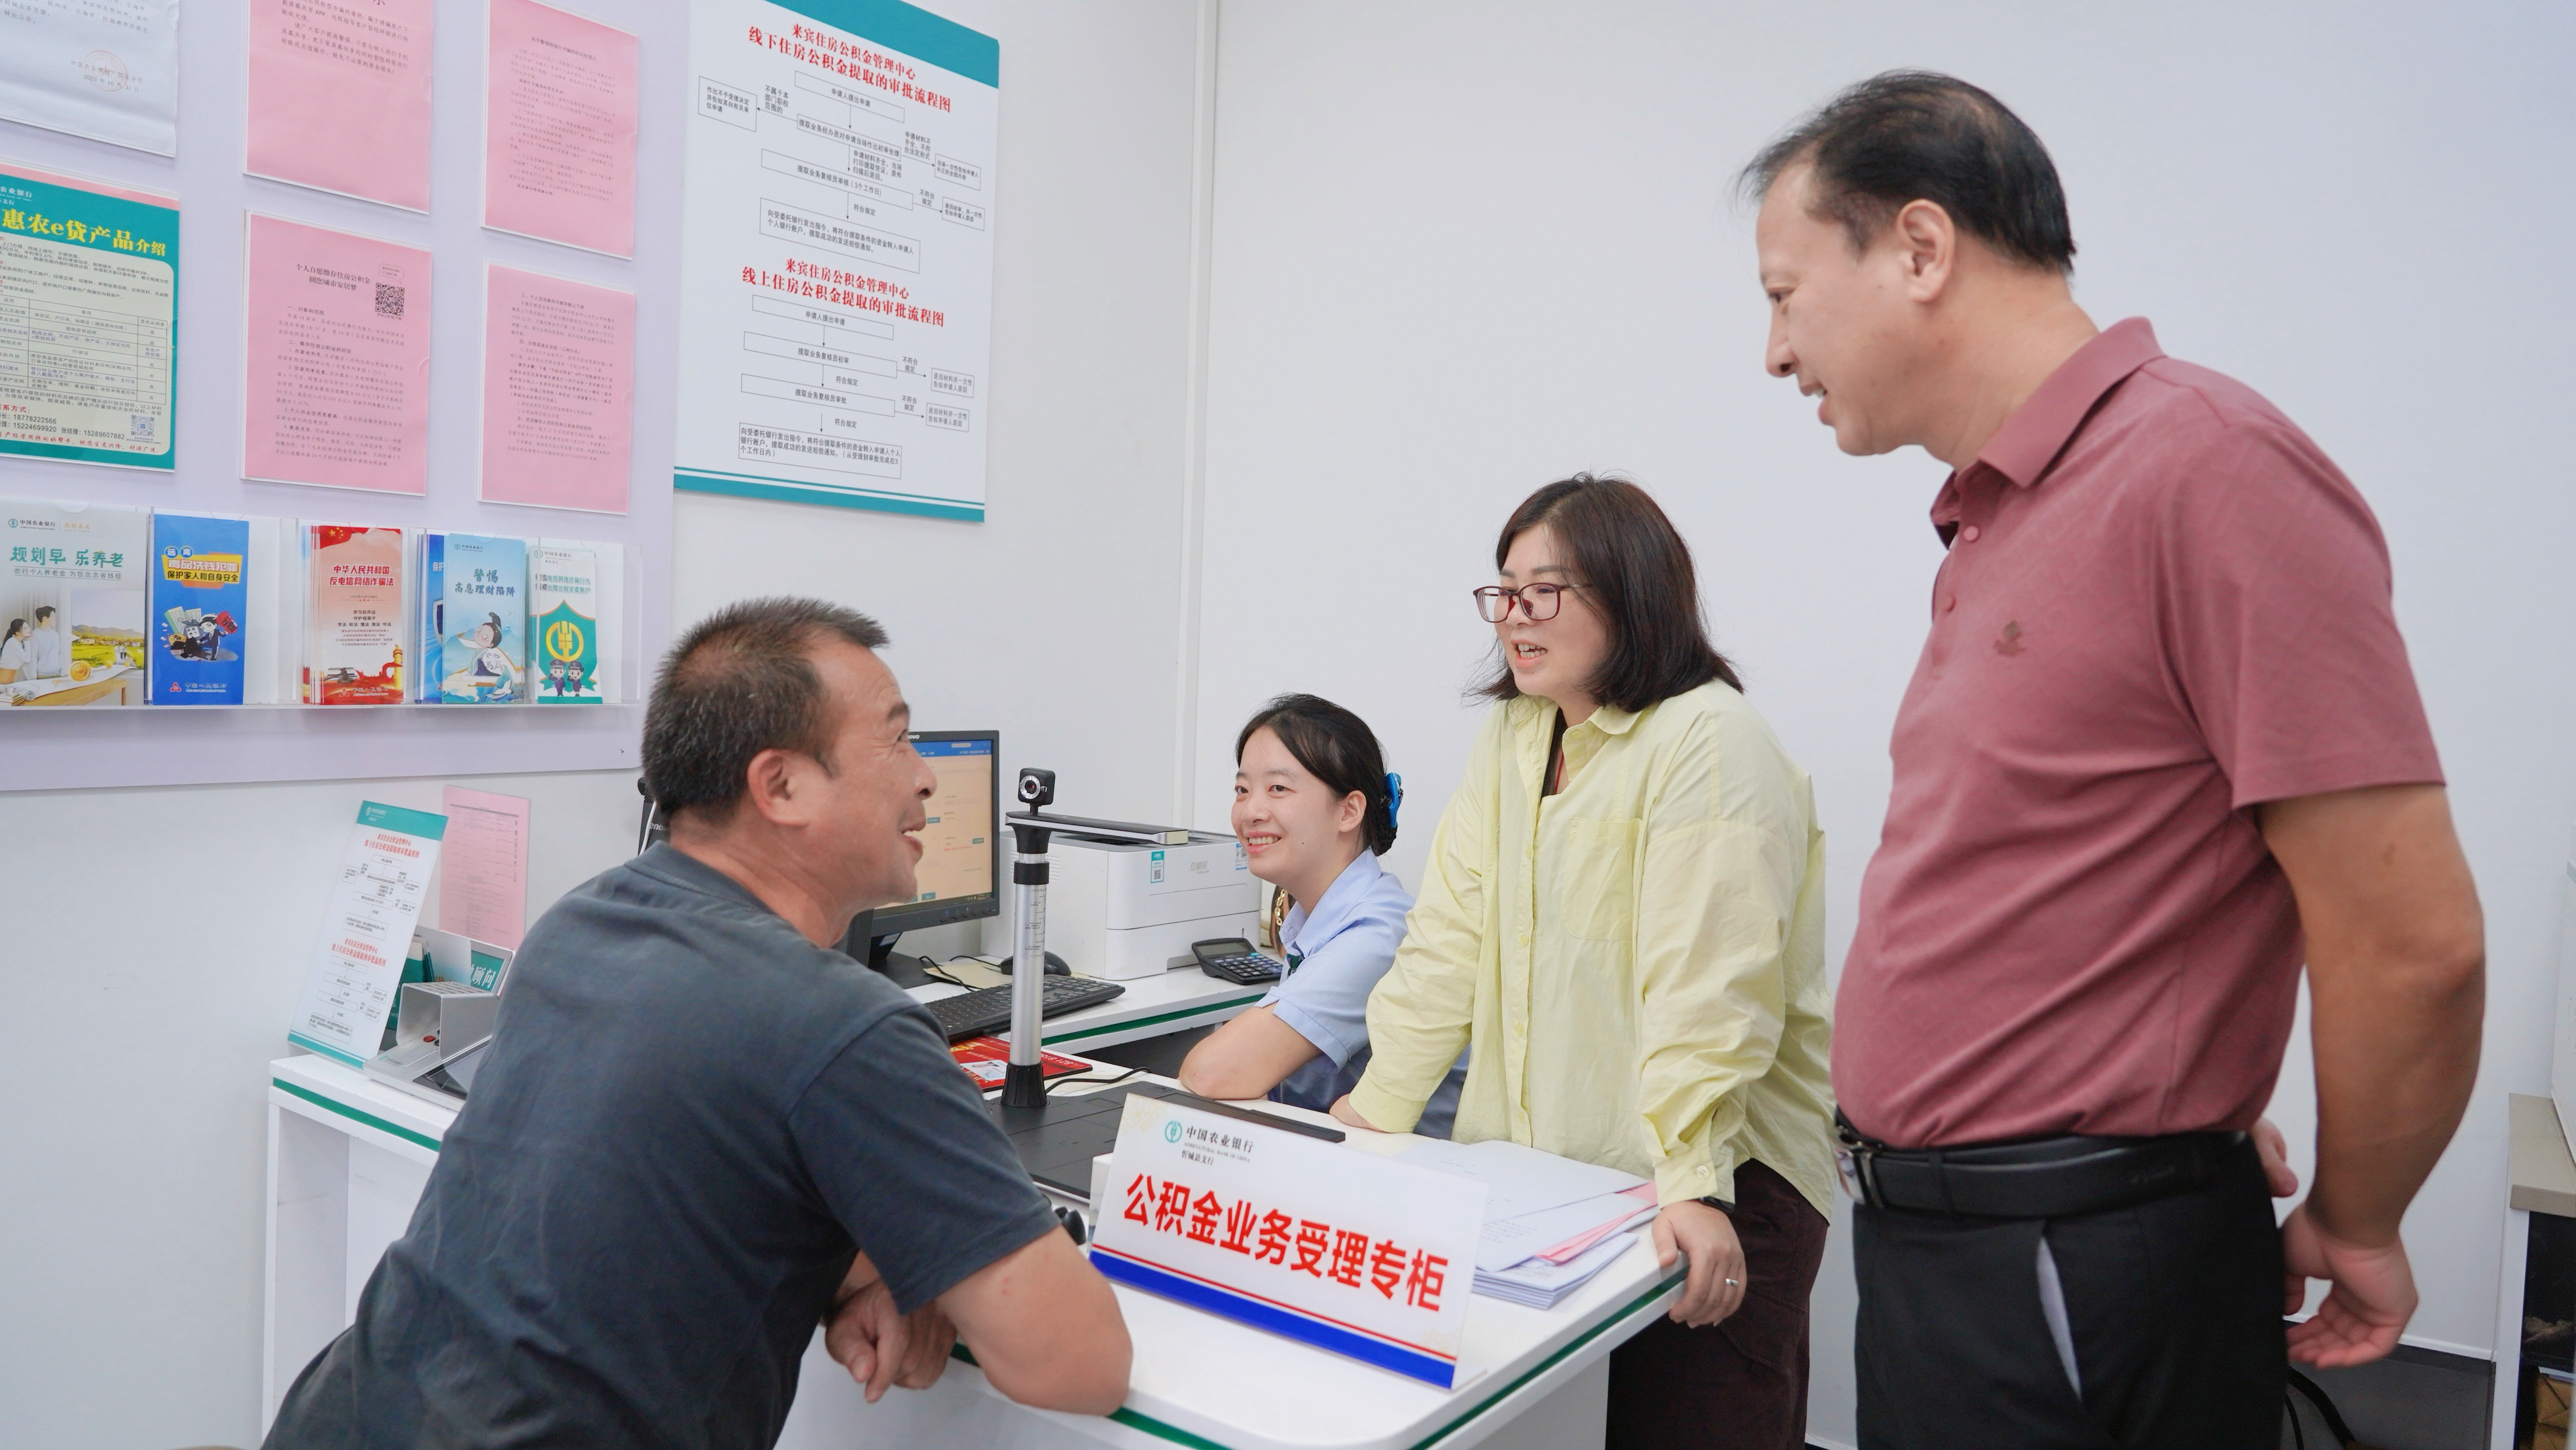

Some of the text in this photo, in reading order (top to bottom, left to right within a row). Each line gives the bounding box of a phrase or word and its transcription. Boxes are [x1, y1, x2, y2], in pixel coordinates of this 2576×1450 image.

[791, 23, 916, 80] 来宾住房公积金管理中心
[749, 26, 951, 113] 线下住房公积金提取的审批流程图
[707, 86, 750, 106] 作出不予受理决定
[764, 84, 789, 99] 不属于本
[831, 87, 870, 108] 申请人提出申请
[706, 94, 749, 113] 并告知其向有关单
[706, 102, 723, 113] 位申请
[764, 94, 789, 108] 部门职权
[764, 101, 783, 114] 范围的
[798, 118, 900, 158] 提取业务经办员对申请当场作出初审处理
[905, 131, 931, 145] 申请材料不
[904, 147, 931, 161] 合法定形式
[937, 160, 979, 178] 当场一次性告知申请人
[937, 167, 967, 181] 补正的全部内容
[0, 185, 32, 198] 农业银行
[920, 188, 935, 200] 不符合
[0, 198, 14, 206] 支行
[922, 198, 933, 207] 规定
[853, 203, 876, 216] 符合规定
[1, 206, 166, 257] 惠农e贷产品介绍
[296, 262, 370, 285] 个人自愿缴存住房公积金
[785, 258, 910, 300] 来宾住房公积金管理中心
[308, 275, 358, 291] 圆您城市安居梦
[742, 266, 944, 327] 线上住房公积金提取的审批流程图
[805, 311, 846, 326] 申请人提出申请
[0, 327, 27, 336] 房相关证件
[65, 326, 96, 335] 提供原件拍照
[798, 347, 850, 364] 提取业务复核员初审
[903, 356, 918, 366] 不符合
[836, 376, 858, 387] 符合规定
[933, 372, 973, 386] 退回材料并一次性
[933, 381, 968, 393] 告知申请人原因
[795, 389, 848, 404] 提取业务复核员审批
[902, 395, 918, 404] 不符合
[0, 403, 30, 413] 系方式：
[834, 418, 857, 429] 符合规定
[20, 519, 56, 527] 中国农业银行
[10, 546, 124, 569] 规划早 乐养老
[167, 548, 191, 556] 远离
[14, 567, 66, 576] 农行个人养老金
[168, 559, 240, 573] 毒品洗钱犯罪
[333, 565, 390, 575] 中华人民共和国
[167, 571, 239, 582] 保护家人和自身安全
[329, 576, 395, 586] 反电信网络诈骗法
[473, 568, 499, 583] 警惕
[455, 582, 516, 597] 高息理财陷阱
[470, 963, 496, 989] 顾问
[1187, 1125, 1254, 1153] 中国农业银行
[1181, 1149, 1215, 1165] 忻城县支行
[1123, 1173, 1449, 1313] 公积金业务受理专柜
